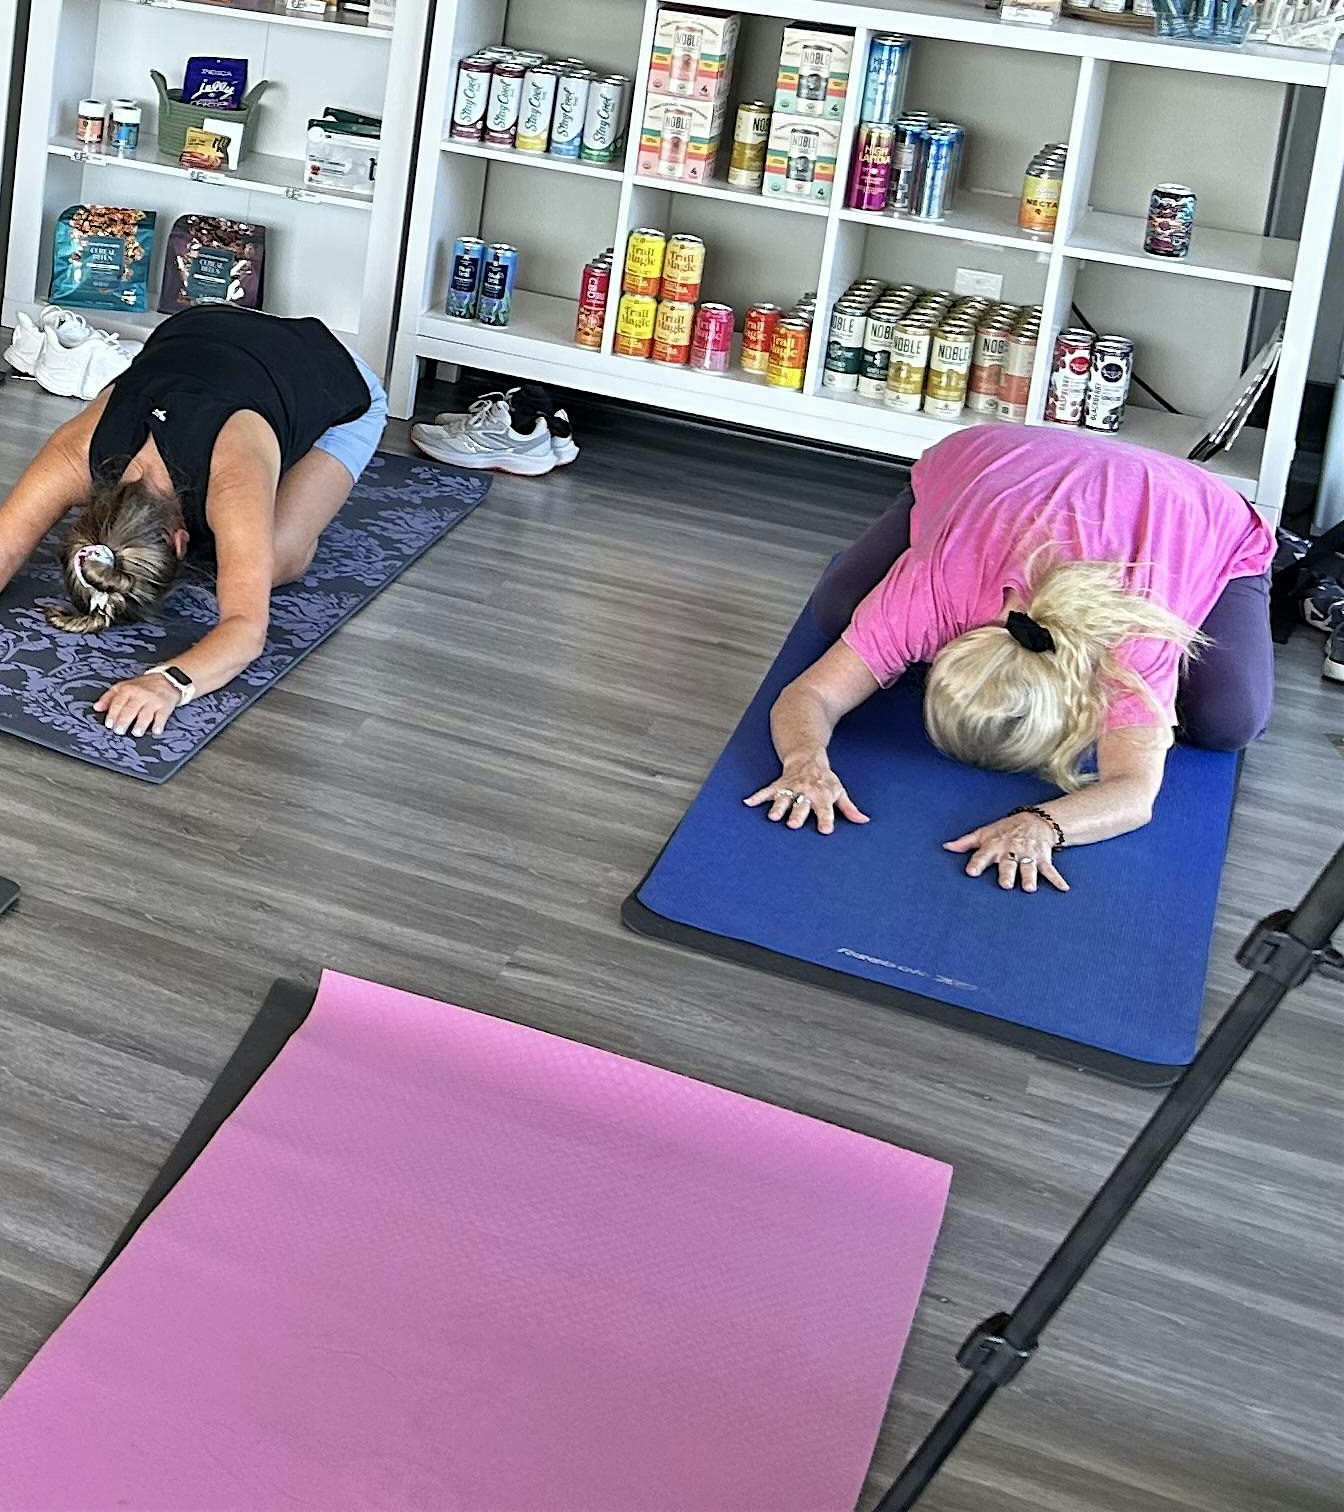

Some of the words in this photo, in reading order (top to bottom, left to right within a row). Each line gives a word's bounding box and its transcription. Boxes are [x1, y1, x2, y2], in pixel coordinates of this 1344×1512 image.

[191, 79, 236, 100] jelly
[753, 117, 771, 132] NOB
[1026, 198, 1058, 209] NECTA
[89, 247, 115, 256] CEREAL
[831, 315, 855, 334] OBLE
[871, 322, 894, 339] NOB
[893, 336, 921, 355] NOBLE
[938, 343, 968, 361] NOBLE
[983, 338, 1004, 354] NOB
